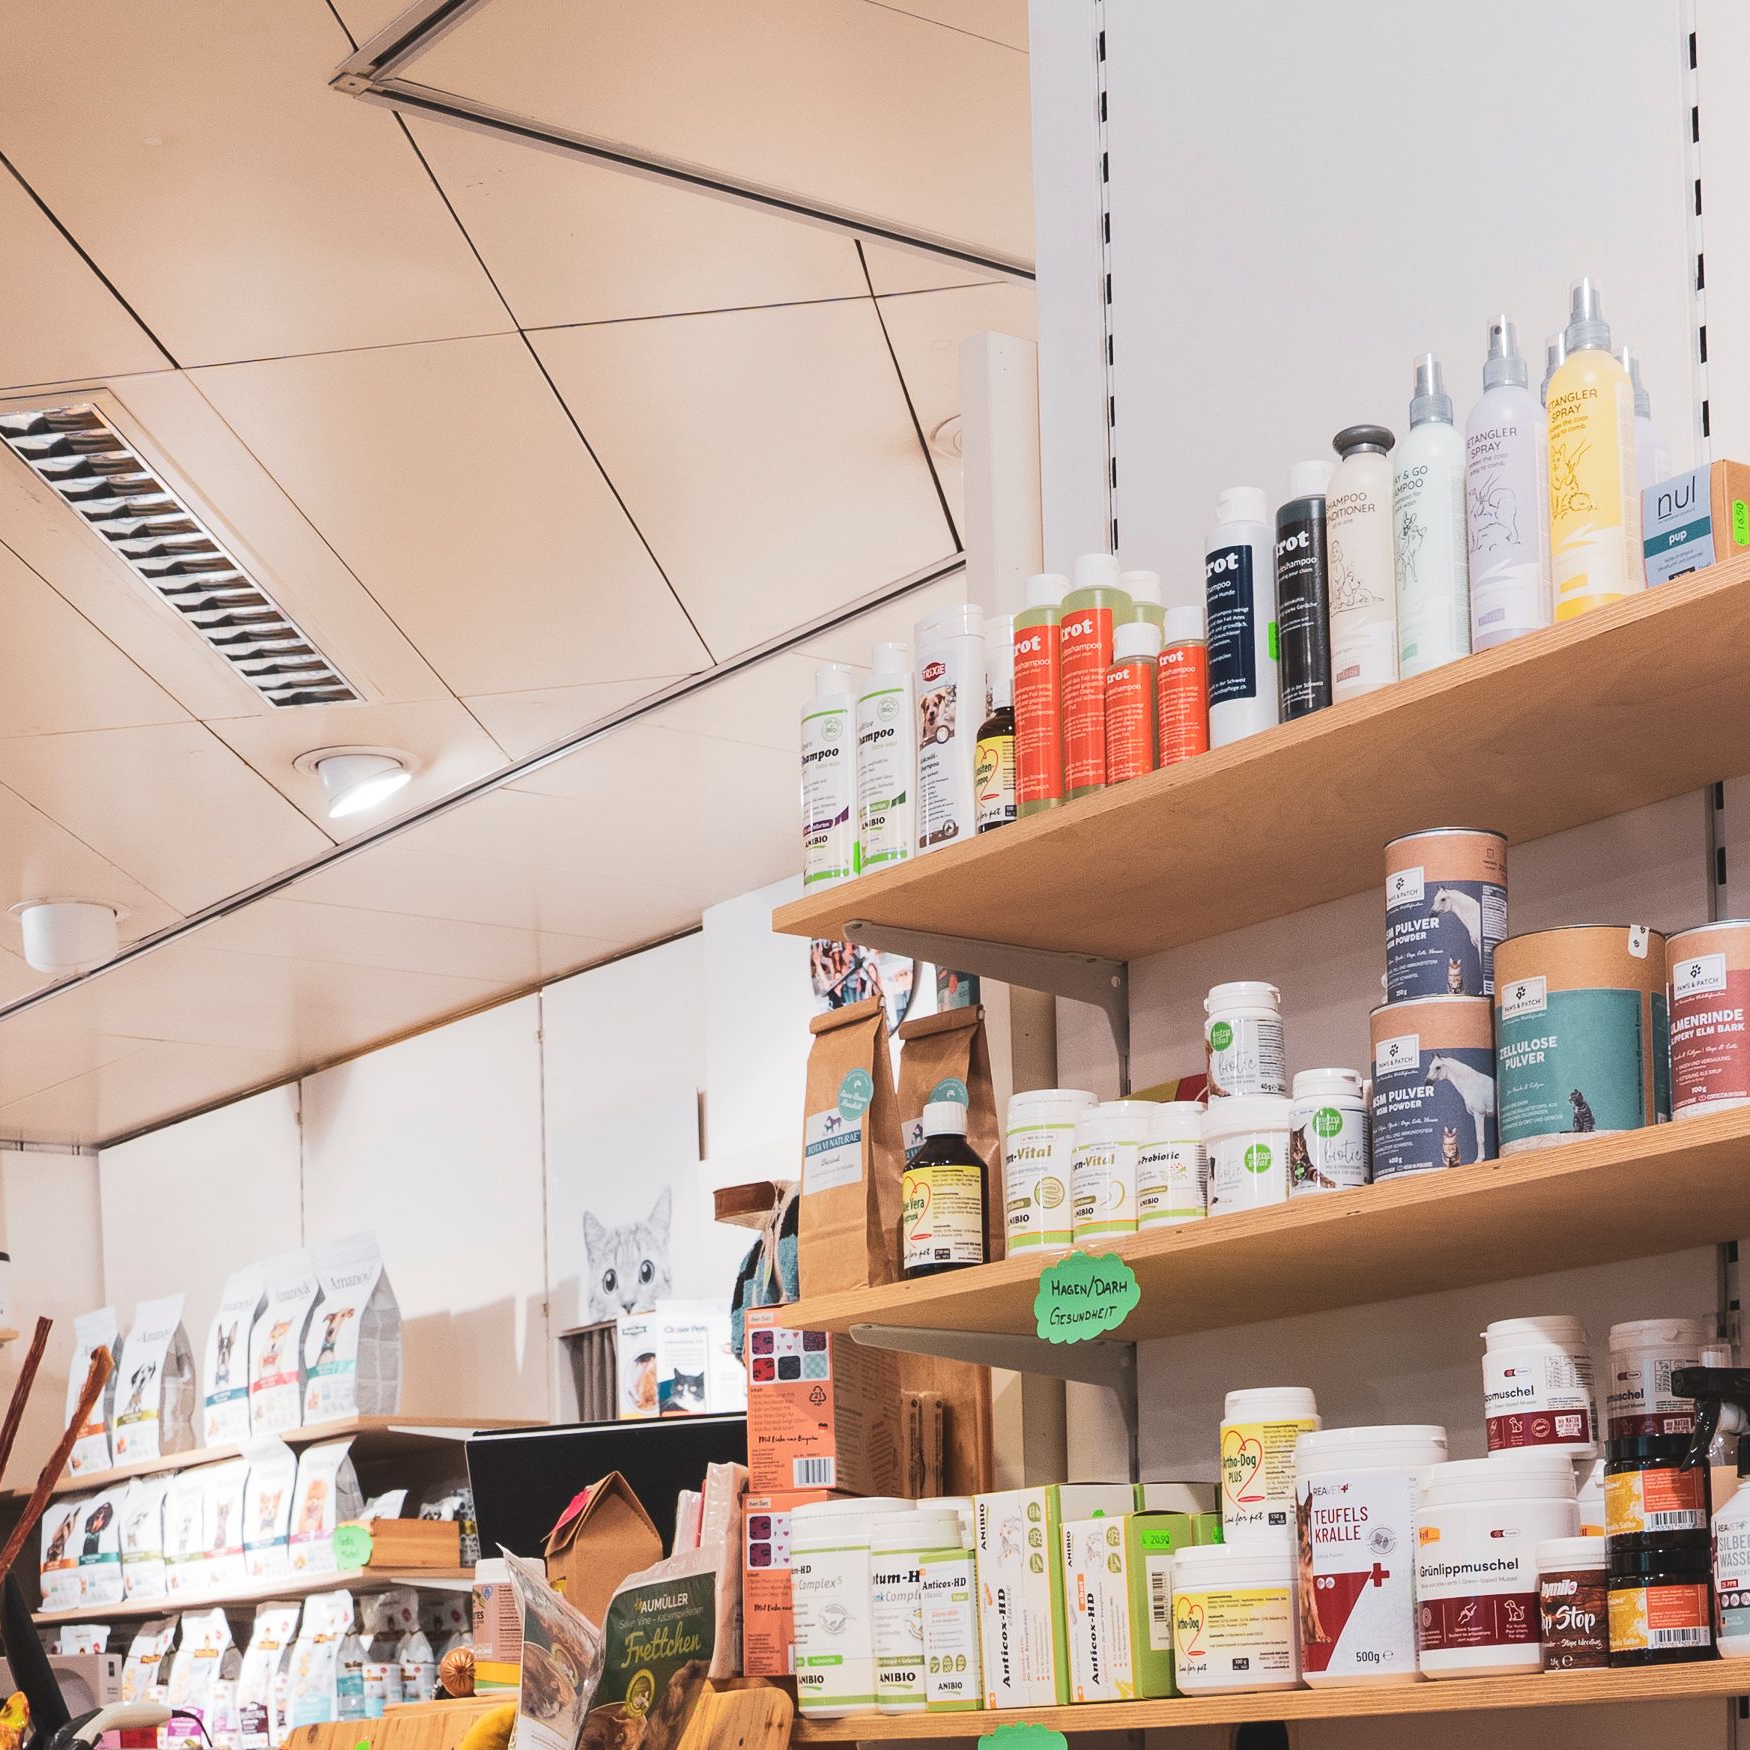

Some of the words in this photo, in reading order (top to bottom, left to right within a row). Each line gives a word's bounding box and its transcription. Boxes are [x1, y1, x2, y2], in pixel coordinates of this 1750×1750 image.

[1668, 528, 1688, 547] pup
[1717, 1021, 1745, 1035] BARK
[1499, 1035, 1558, 1061] ZELLULOSE
[1505, 1051, 1546, 1071] PULVER
[1389, 1085, 1435, 1103] PULVER
[1387, 1100, 1422, 1115] POWDER
[1049, 1306, 1117, 1325] GESUNDHEIT
[1313, 1506, 1369, 1526] TEUFELS
[1314, 1524, 1362, 1544] KRALLE
[1420, 1557, 1519, 1578] Grünlippmuschel
[1555, 1605, 1596, 1632] Stop
[620, 1620, 702, 1669] Frettchen
[997, 1587, 1011, 1689] Anticox-HD
[1086, 1592, 1101, 1685] Anticox-HD
[1355, 1651, 1380, 1664] 500g
